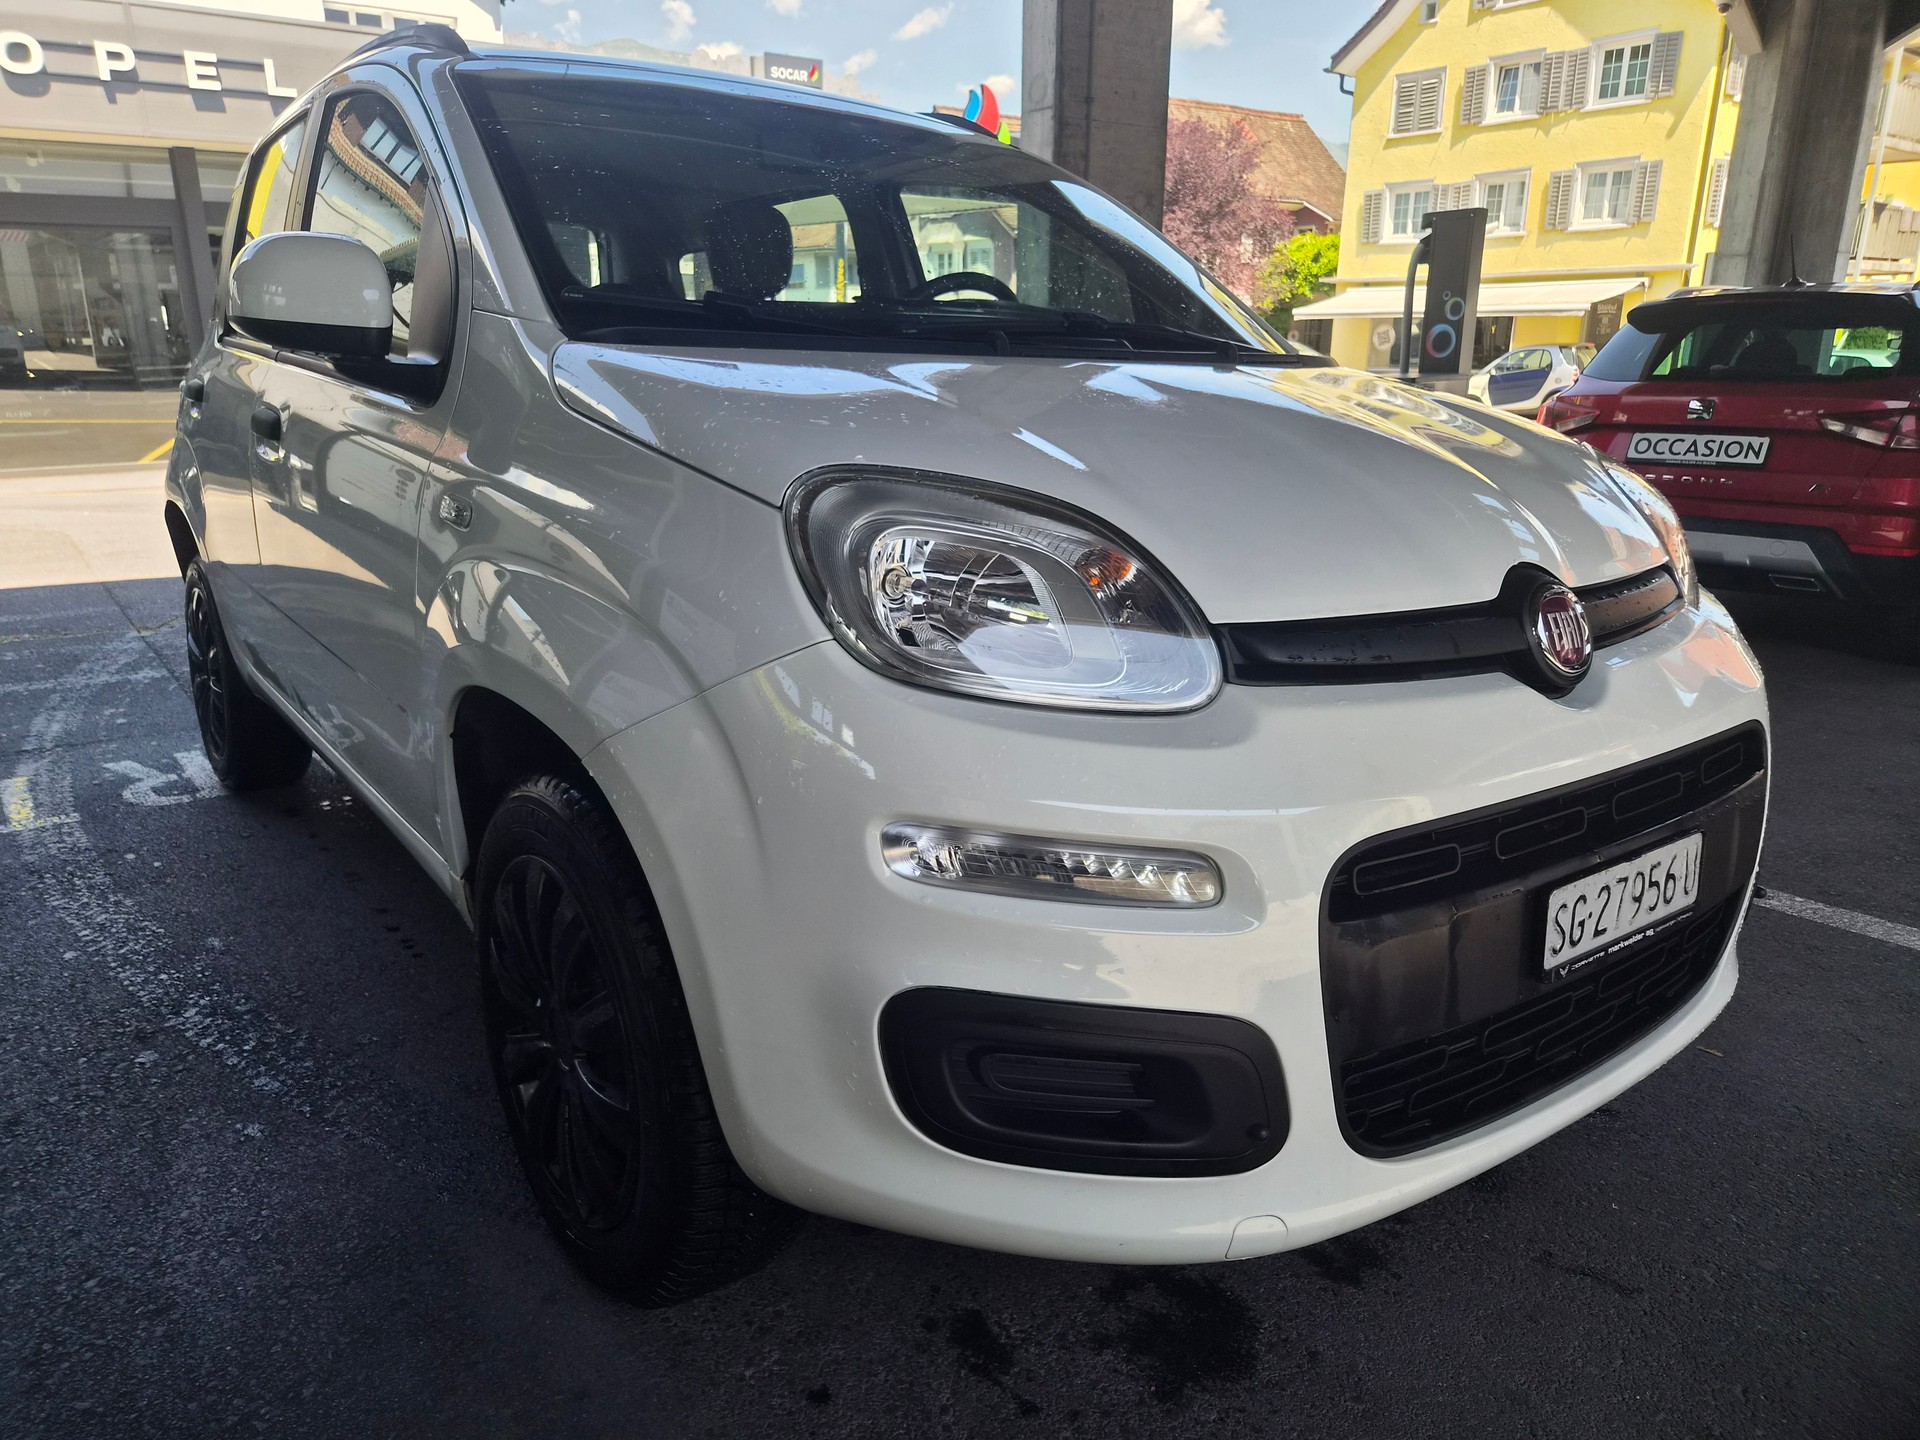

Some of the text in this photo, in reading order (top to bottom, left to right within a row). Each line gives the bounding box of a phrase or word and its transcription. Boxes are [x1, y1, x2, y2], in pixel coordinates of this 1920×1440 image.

[0, 31, 298, 98] OPEL
[770, 66, 808, 82] SOCAR
[1634, 437, 1764, 461] OCCASION
[1547, 607, 1582, 651] FIAT
